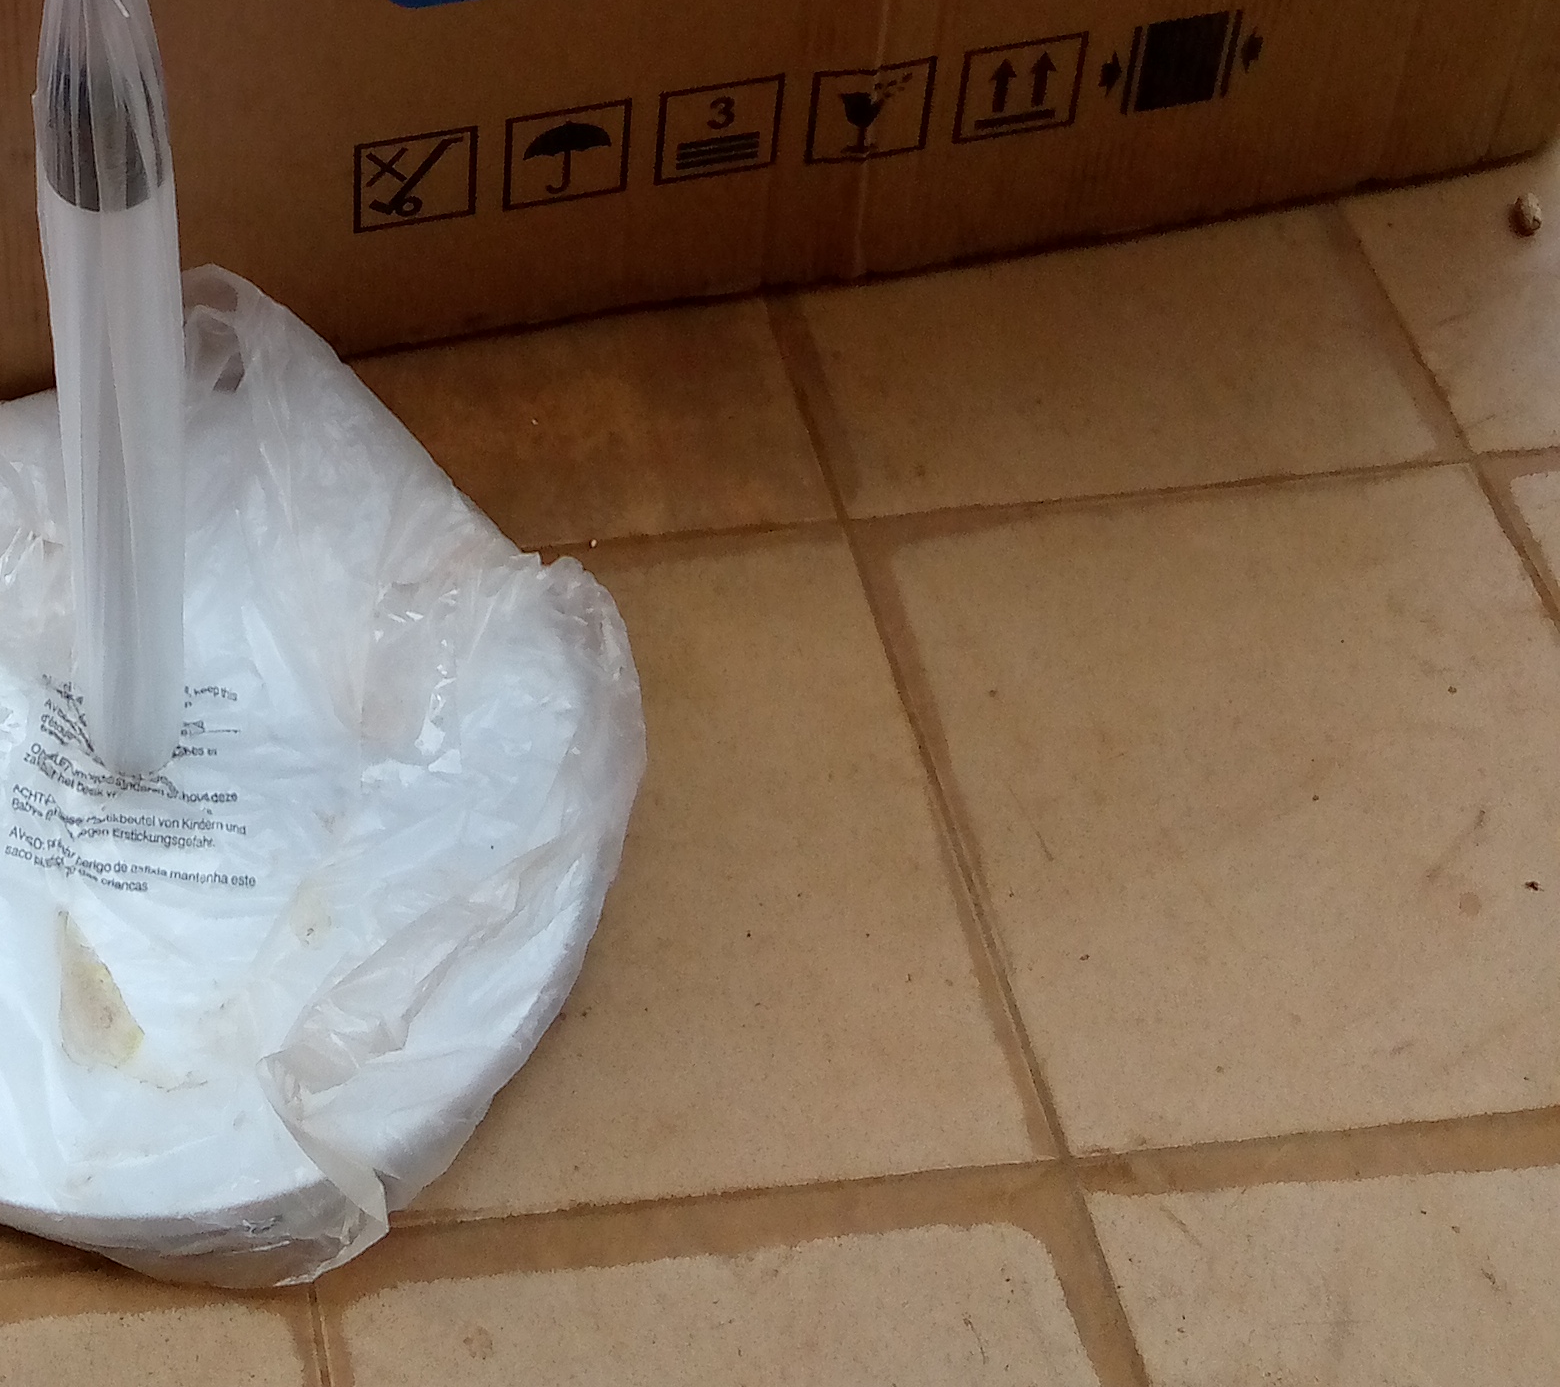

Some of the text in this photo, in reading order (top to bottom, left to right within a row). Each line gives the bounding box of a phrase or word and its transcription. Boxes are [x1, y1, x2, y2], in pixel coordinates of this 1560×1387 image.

[707, 94, 736, 131] 3
[182, 818, 223, 831] Kindern
[225, 823, 246, 835] und
[4, 845, 33, 861] saco
